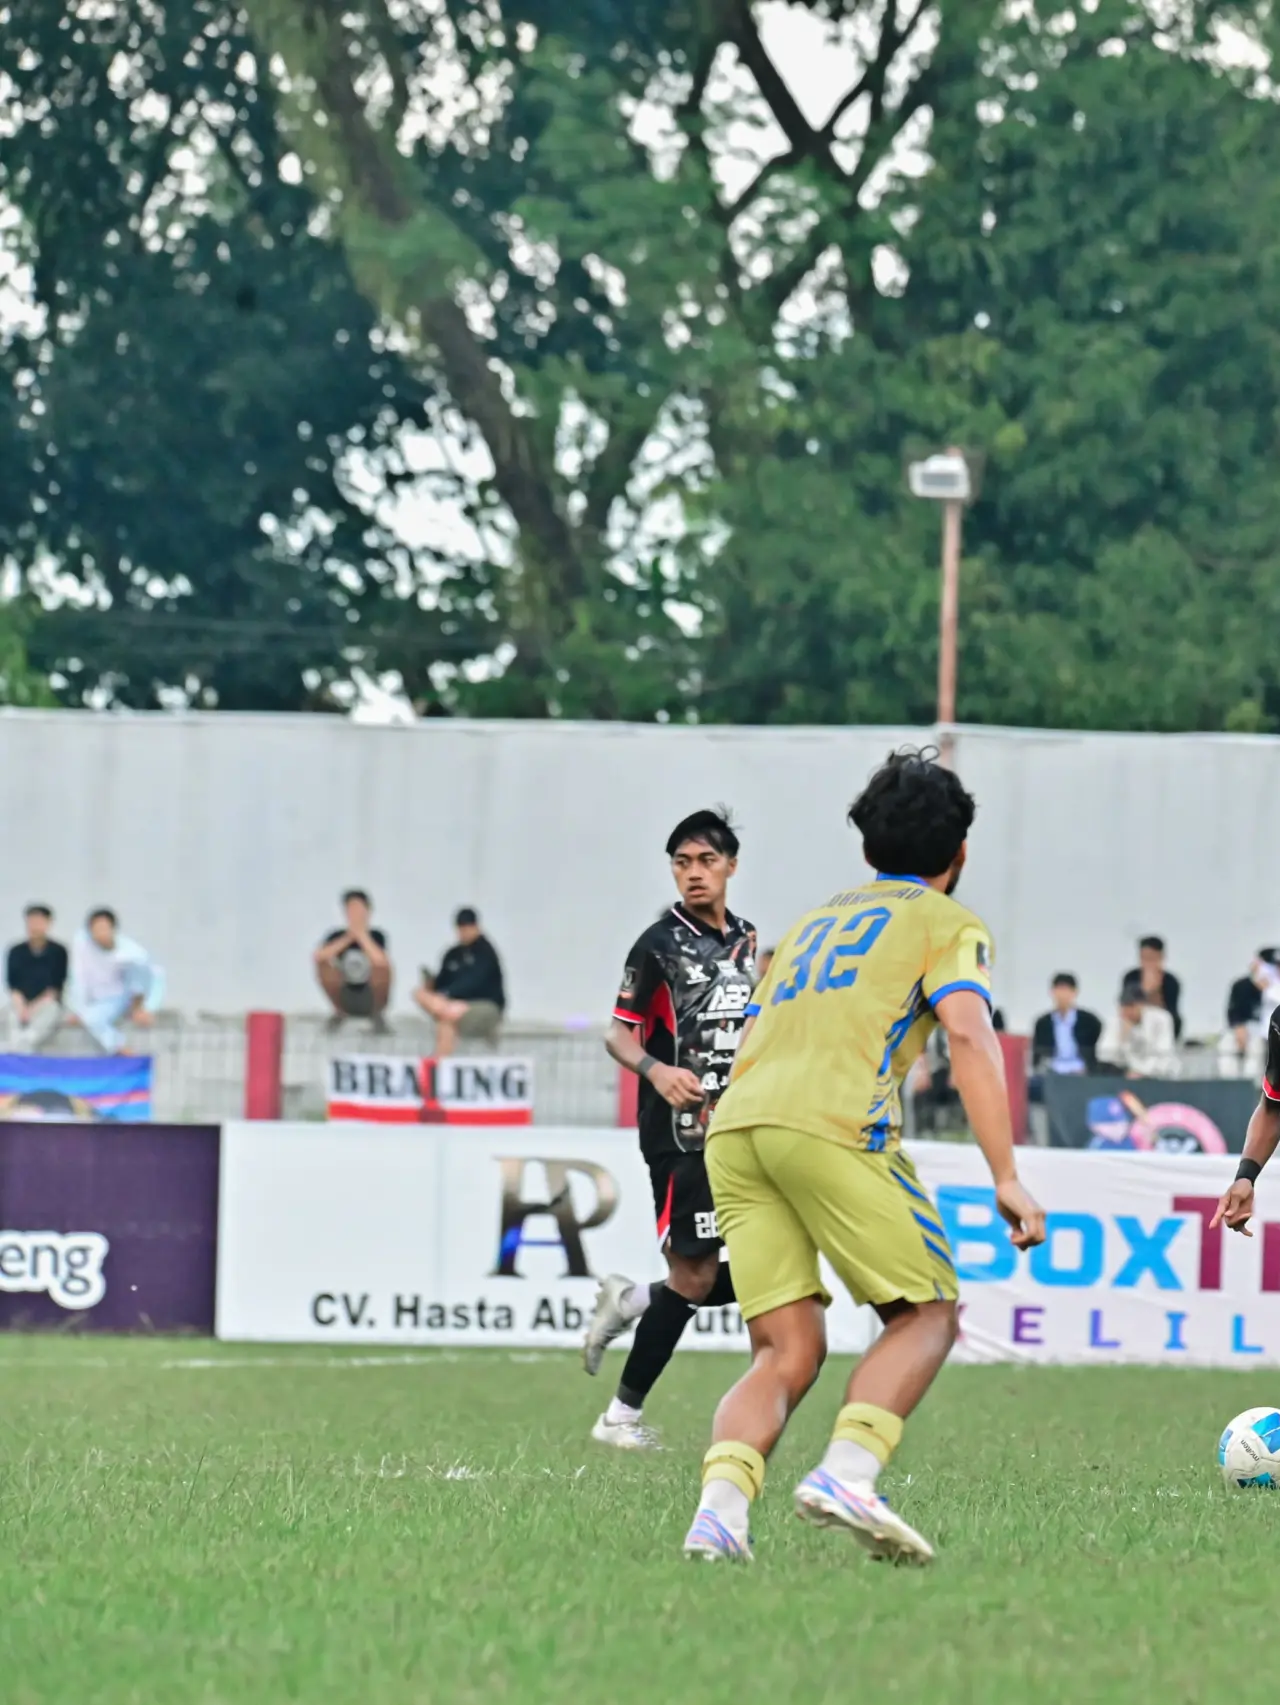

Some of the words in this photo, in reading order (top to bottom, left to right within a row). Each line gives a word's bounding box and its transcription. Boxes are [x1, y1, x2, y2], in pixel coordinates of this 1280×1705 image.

[770, 906, 893, 1006] 32
[312, 1293, 375, 1328] CV.
[394, 1295, 514, 1331] Hasta
